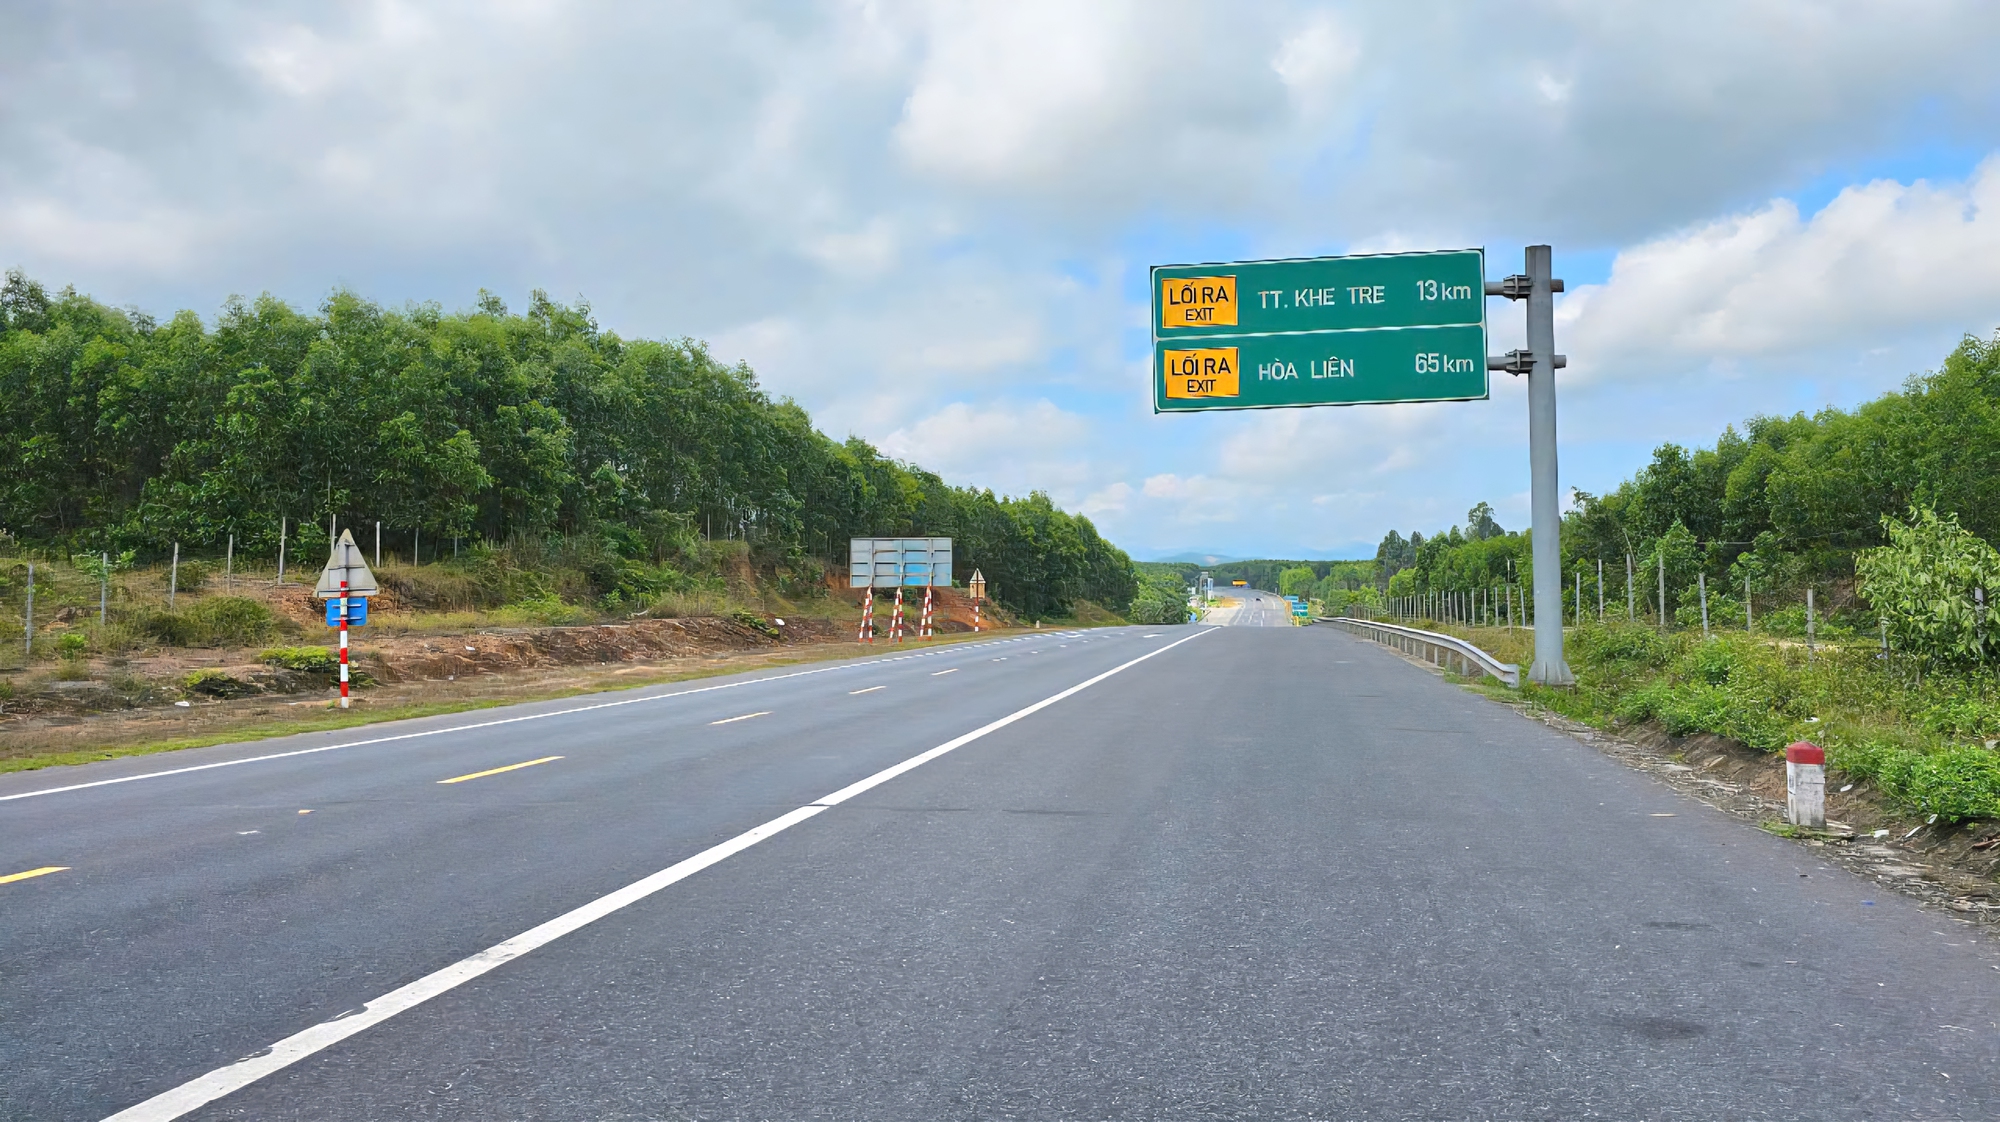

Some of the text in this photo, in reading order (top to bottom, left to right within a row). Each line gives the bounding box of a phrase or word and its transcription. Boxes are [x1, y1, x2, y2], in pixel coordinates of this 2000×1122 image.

[1170, 281, 1229, 305] LỐI RA
[1258, 290, 1289, 309] TT.
[1294, 287, 1336, 307] KHE
[1346, 285, 1386, 305] TRE
[1185, 307, 1215, 321] EXIT
[1204, 357, 1231, 375] RA
[1258, 357, 1299, 381] HÒA
[1310, 355, 1355, 379] LIÊN
[1187, 378, 1217, 393] EXIT
